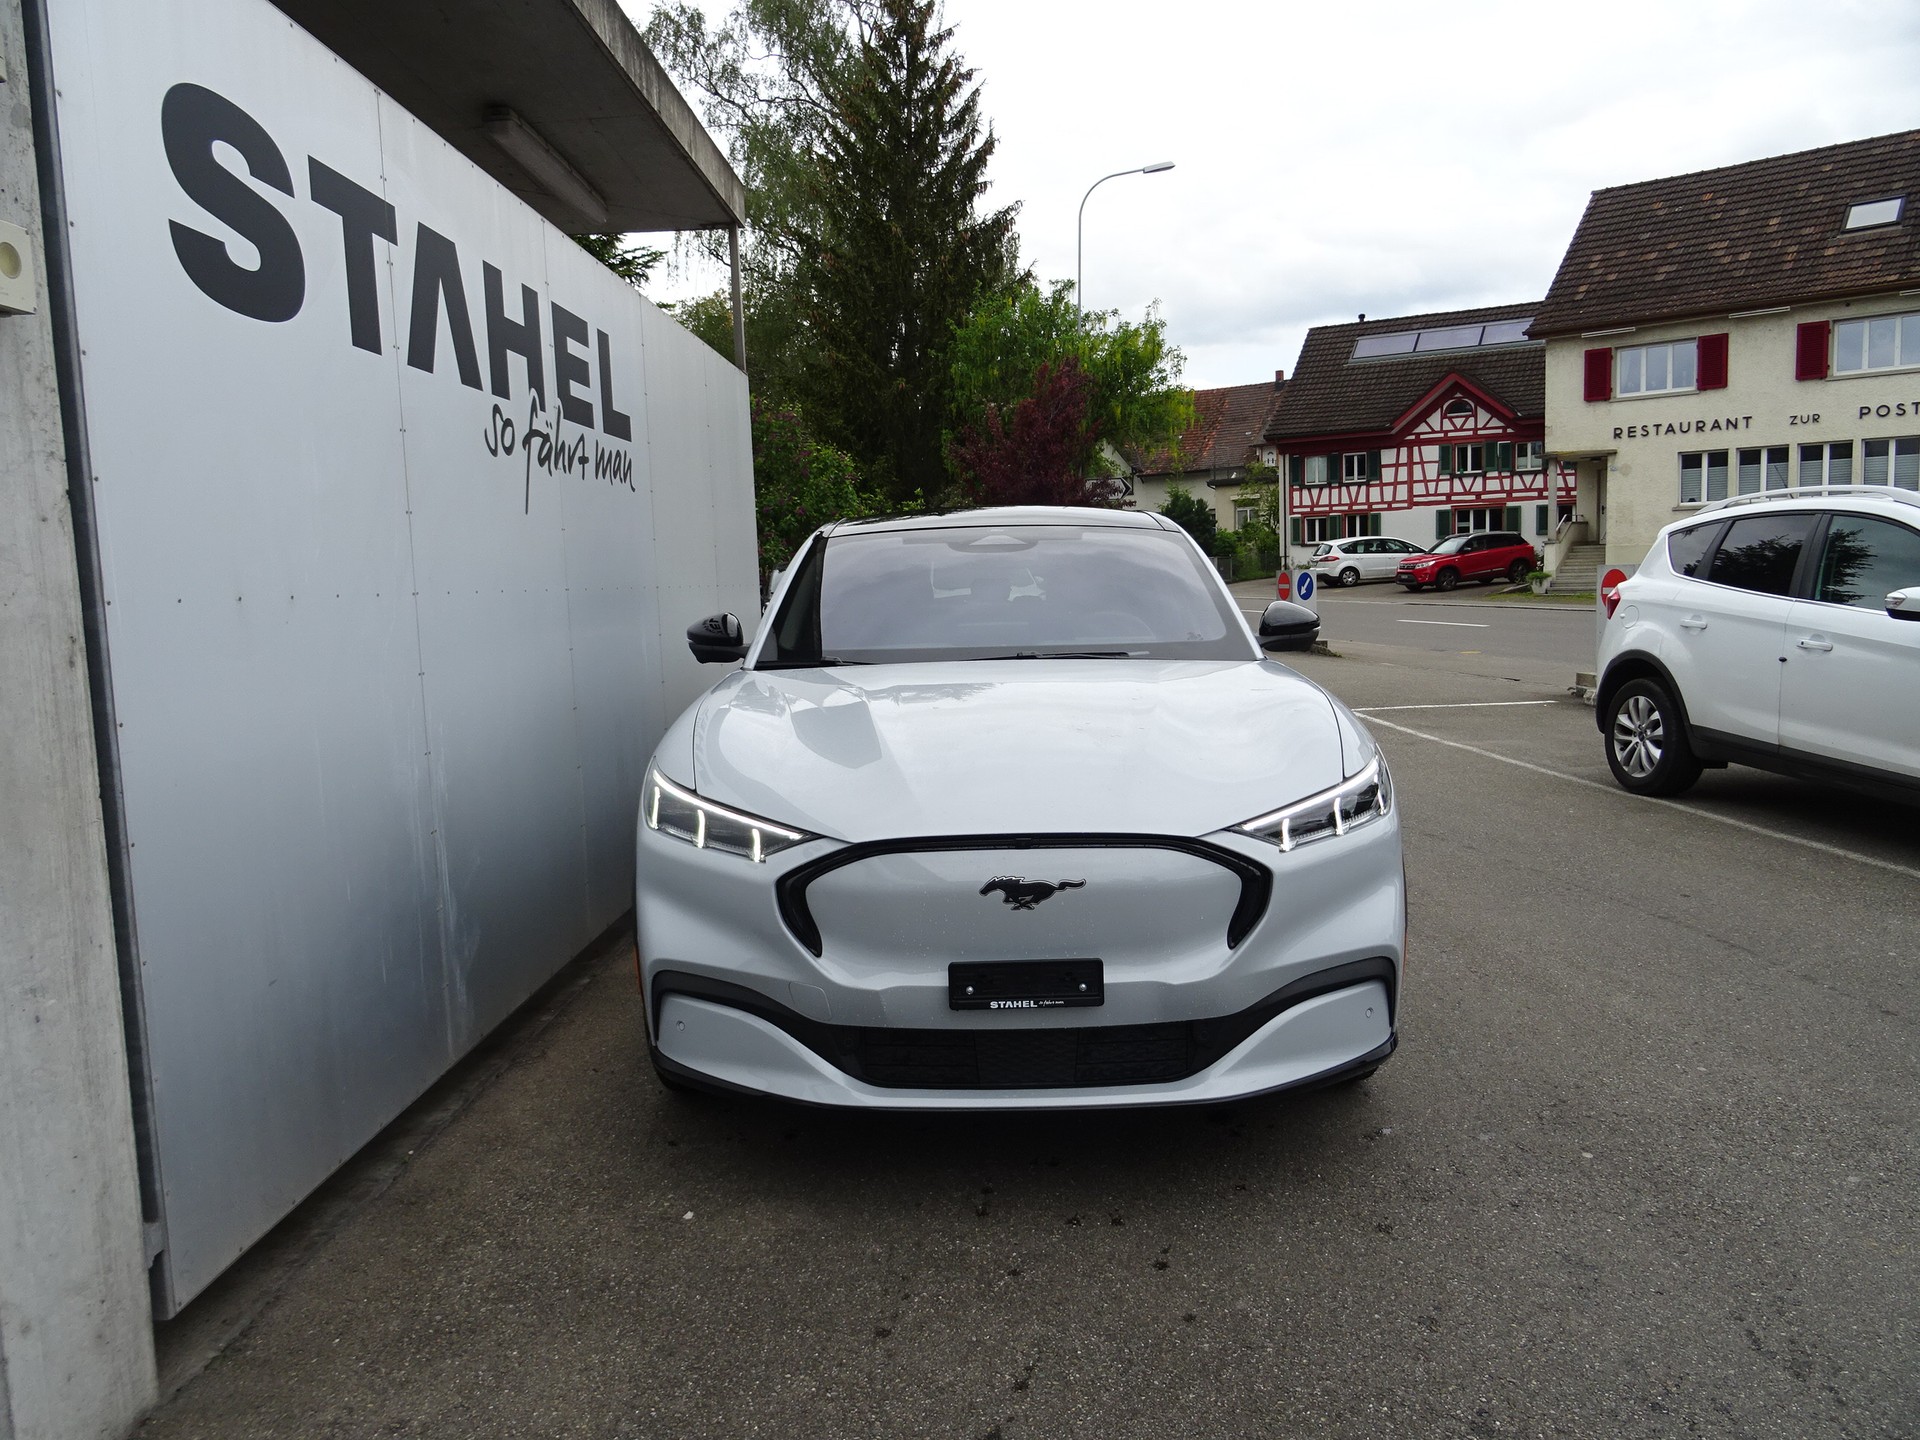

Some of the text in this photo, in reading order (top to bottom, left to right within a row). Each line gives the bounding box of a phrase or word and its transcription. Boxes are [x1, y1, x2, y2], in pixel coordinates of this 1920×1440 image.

[161, 82, 632, 442] STAHEL
[485, 395, 635, 515] so fährt man
[1613, 401, 1920, 439] RESTAURANT ZUR POST
[990, 1000, 1038, 1009] STAHEL
